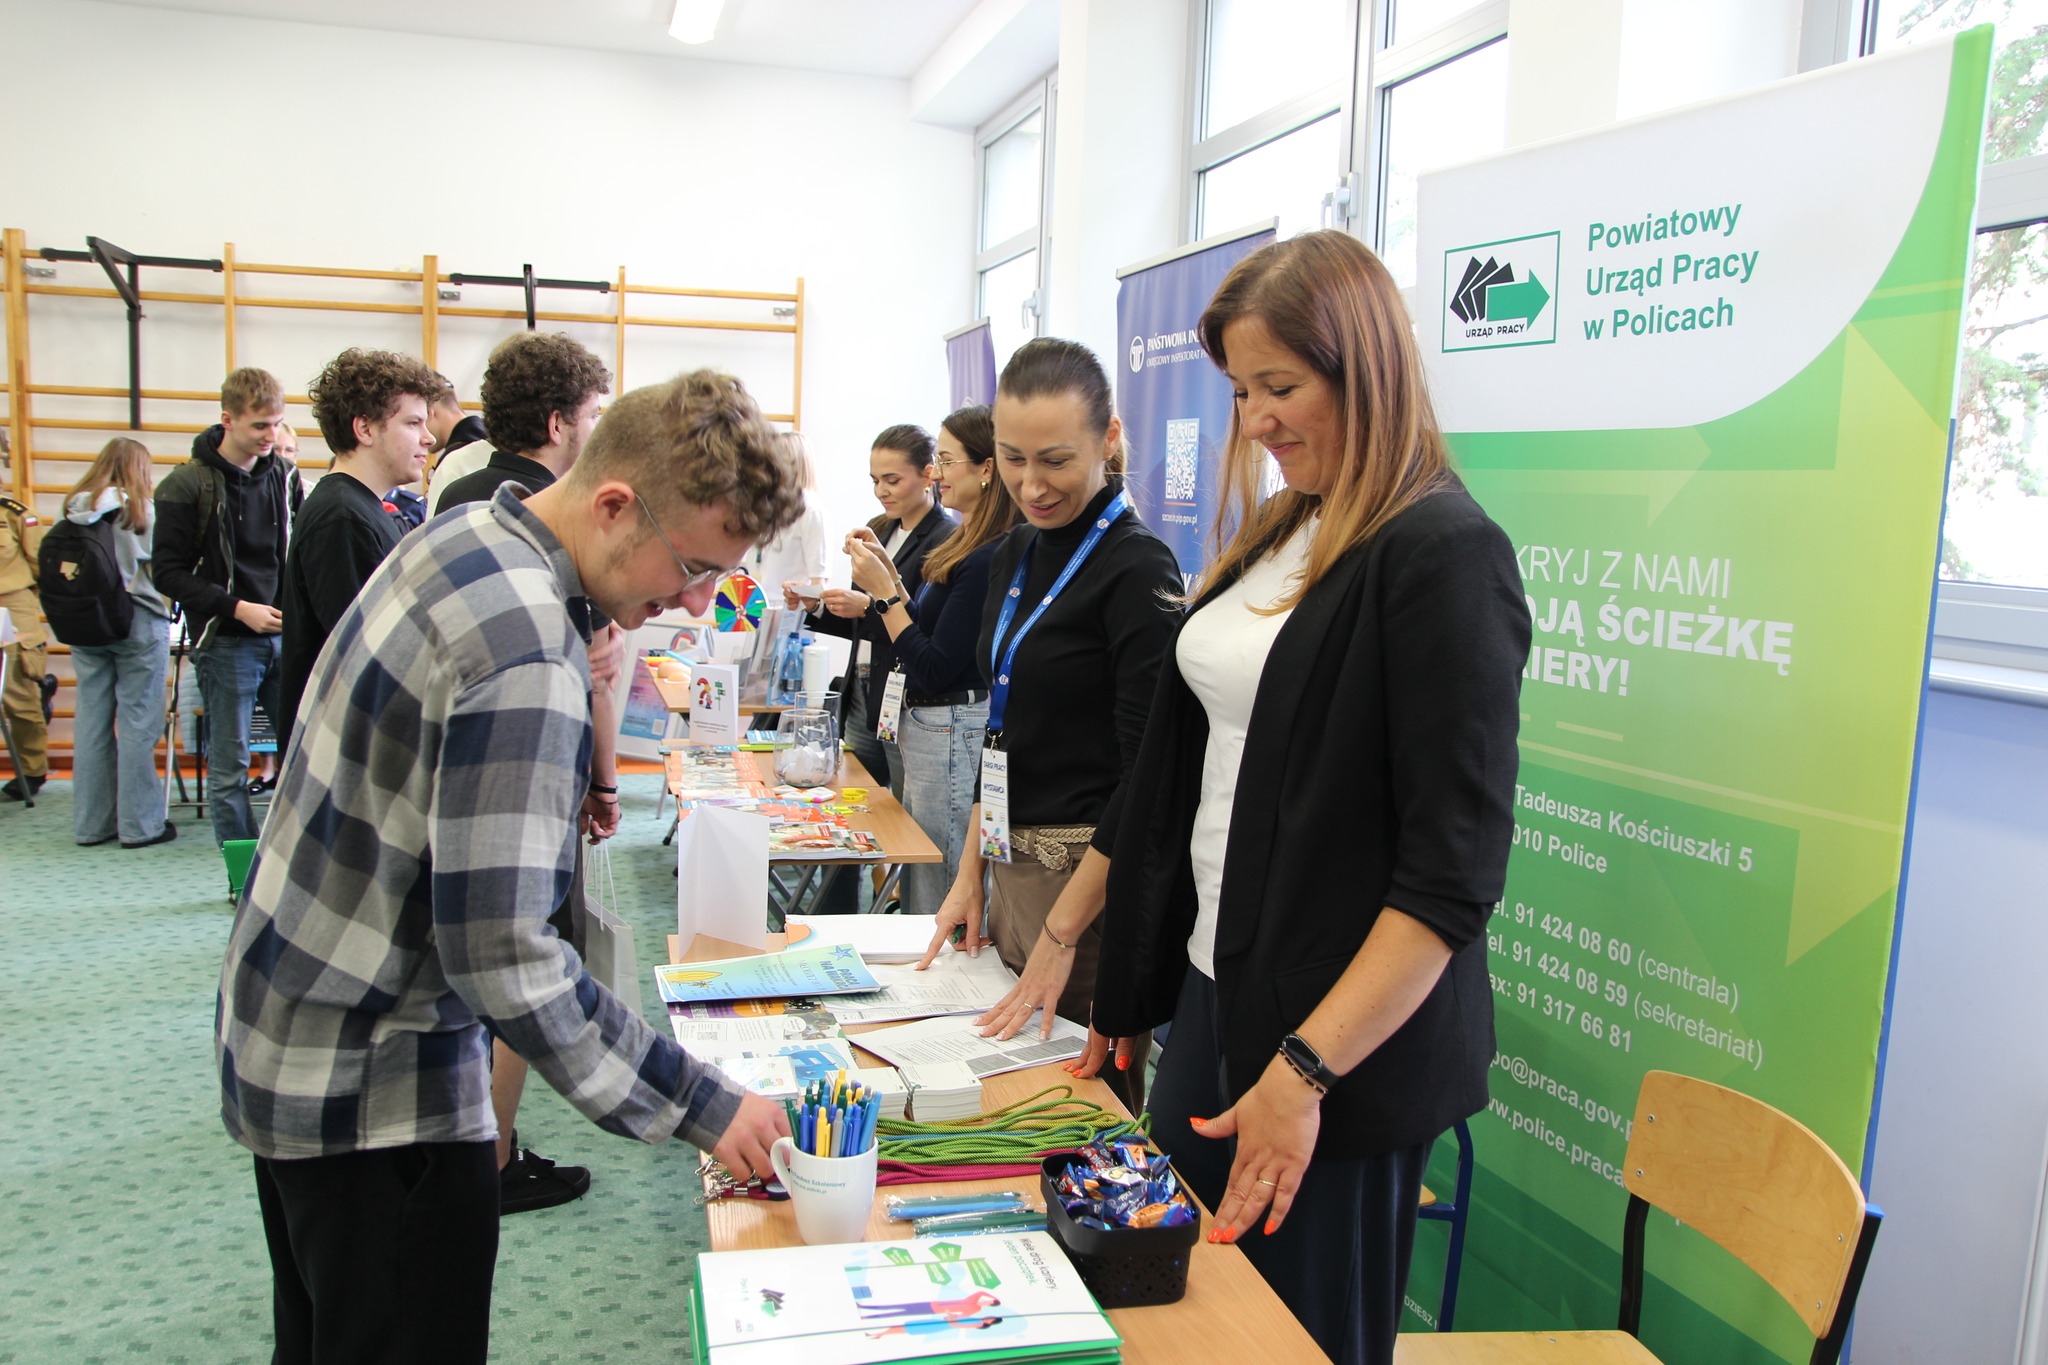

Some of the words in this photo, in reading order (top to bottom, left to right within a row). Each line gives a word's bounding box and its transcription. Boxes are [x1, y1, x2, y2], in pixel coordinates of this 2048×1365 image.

[1588, 203, 1742, 251] Powiatowy
[1587, 258, 1663, 296] Urząd
[1673, 250, 1759, 284] Pracy
[1465, 327, 1493, 338] URZĄD
[1497, 324, 1525, 335] PRACY
[1583, 318, 1604, 340] w
[1612, 297, 1734, 338] Policach
[1599, 550, 1623, 589] Z
[1633, 553, 1730, 599] NAMI
[1597, 595, 1794, 676] ŚCIEŻKĘ
[1515, 784, 1602, 830] Tadeusza
[1608, 810, 1731, 867] Kościuszki
[1738, 846, 1753, 873] 5
[1548, 835, 1608, 874] Police
[1515, 902, 1534, 928] 91
[1540, 913, 1573, 943] 424
[1579, 927, 1601, 954] 08
[1608, 938, 1632, 966] 60
[1638, 949, 1738, 1014] (centrala)
[1512, 941, 1531, 967] 91
[1537, 953, 1570, 983] 424
[1576, 967, 1598, 995] 08
[1604, 979, 1628, 1007] 59
[1634, 991, 1763, 1071] (sekretariat)
[1517, 982, 1536, 1008] 91
[1543, 994, 1576, 1024] 317
[1581, 1011, 1603, 1039] 66
[1609, 1024, 1631, 1053] 81
